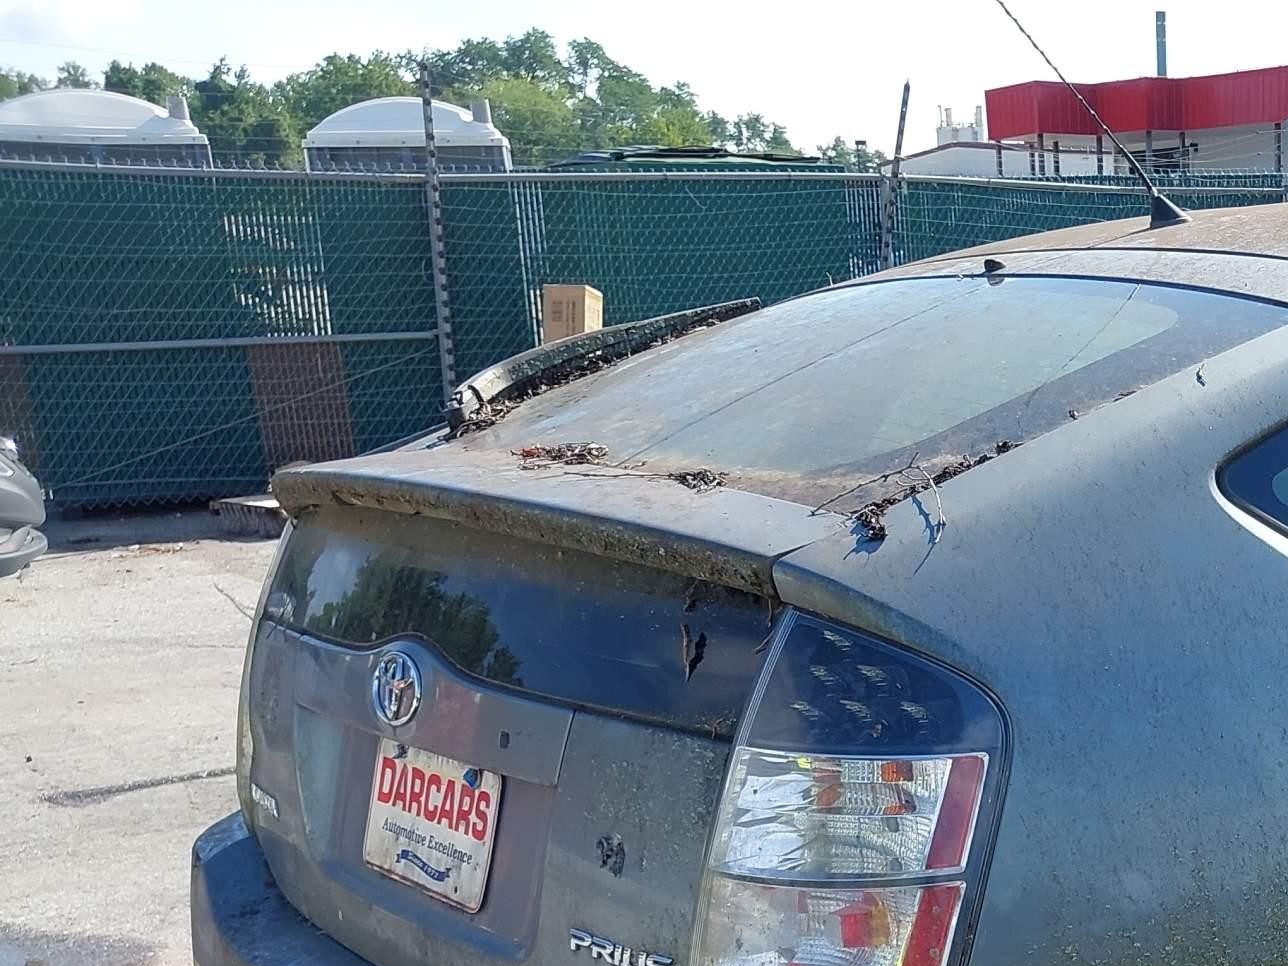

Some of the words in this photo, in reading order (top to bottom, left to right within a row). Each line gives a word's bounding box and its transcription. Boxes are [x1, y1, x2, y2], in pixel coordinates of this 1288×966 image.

[377, 757, 491, 841] DARCARS
[382, 817, 427, 846] Automotive
[427, 834, 473, 865] Excellence
